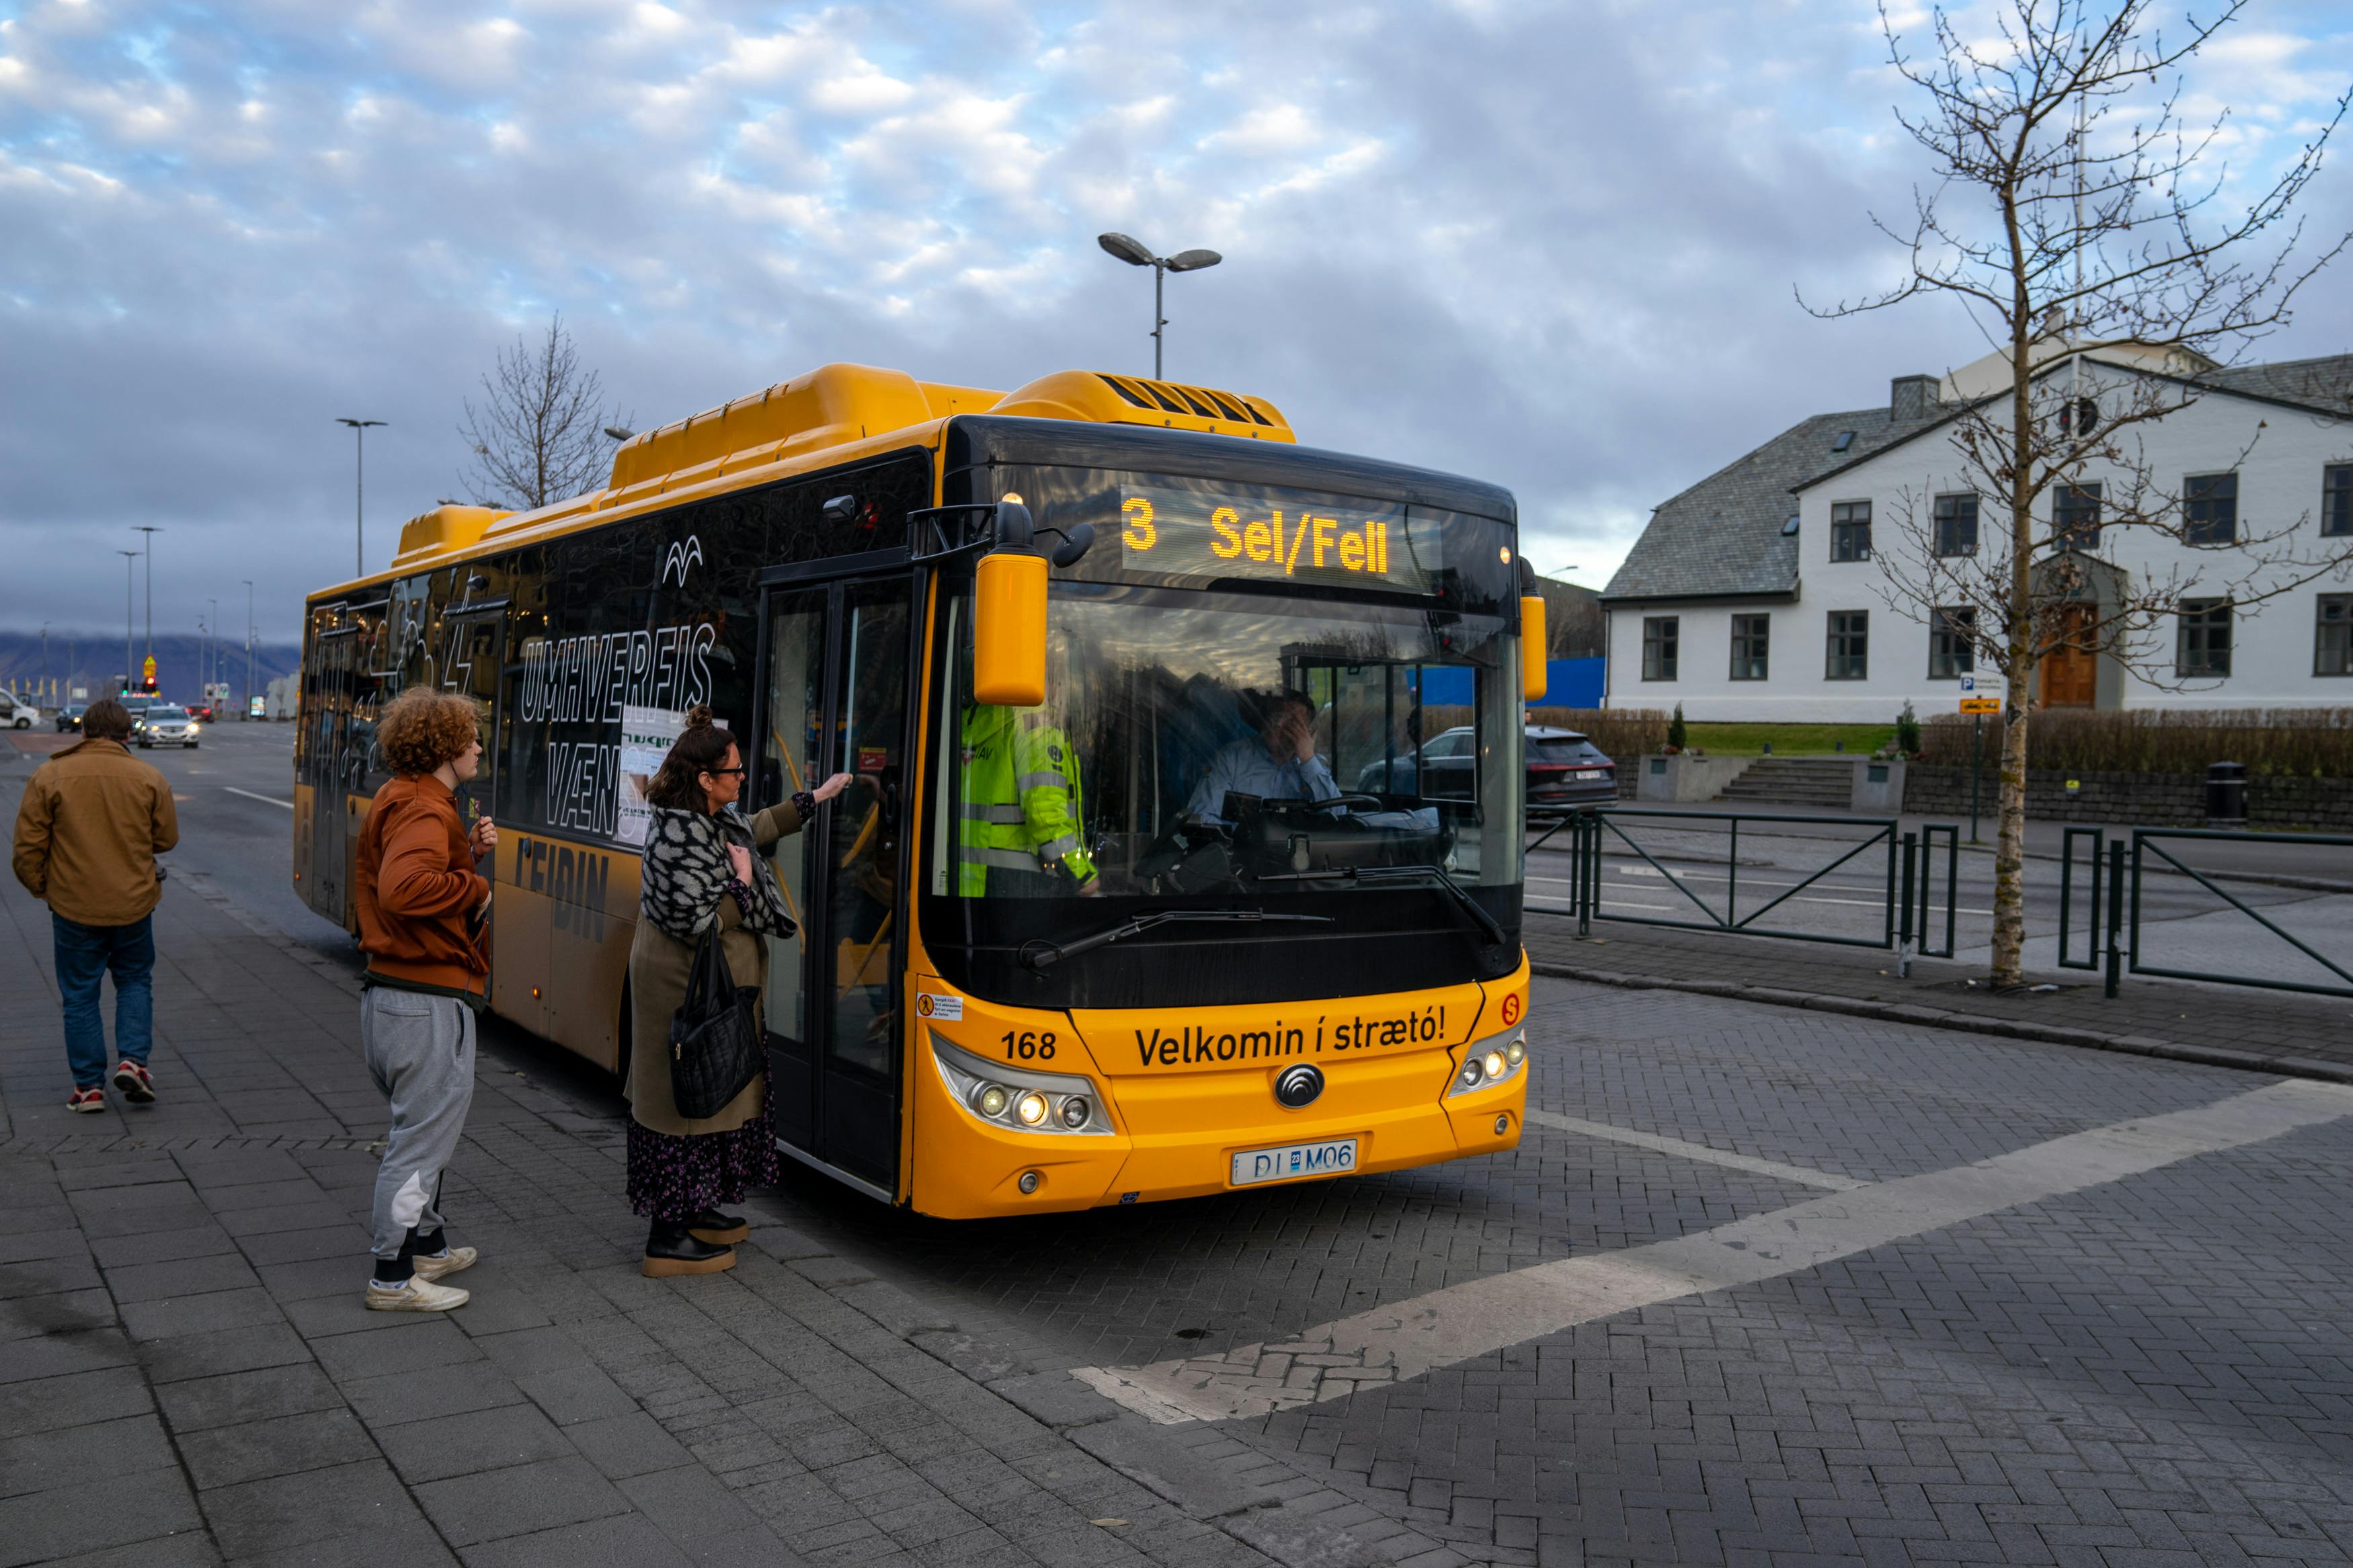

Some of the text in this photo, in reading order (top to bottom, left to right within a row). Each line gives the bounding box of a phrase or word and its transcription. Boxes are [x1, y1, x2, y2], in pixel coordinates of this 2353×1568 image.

[1121, 497, 1388, 575] 3 Sel/Fell
[521, 622, 716, 723] UMHVERFIS
[1001, 1030, 1056, 1060] 168
[1135, 1005, 1445, 1067] Velkomin í strætó!
[1254, 1153, 1281, 1178] DI
[1306, 1145, 1352, 1173] M06
[1290, 1153, 1300, 1164] 23
